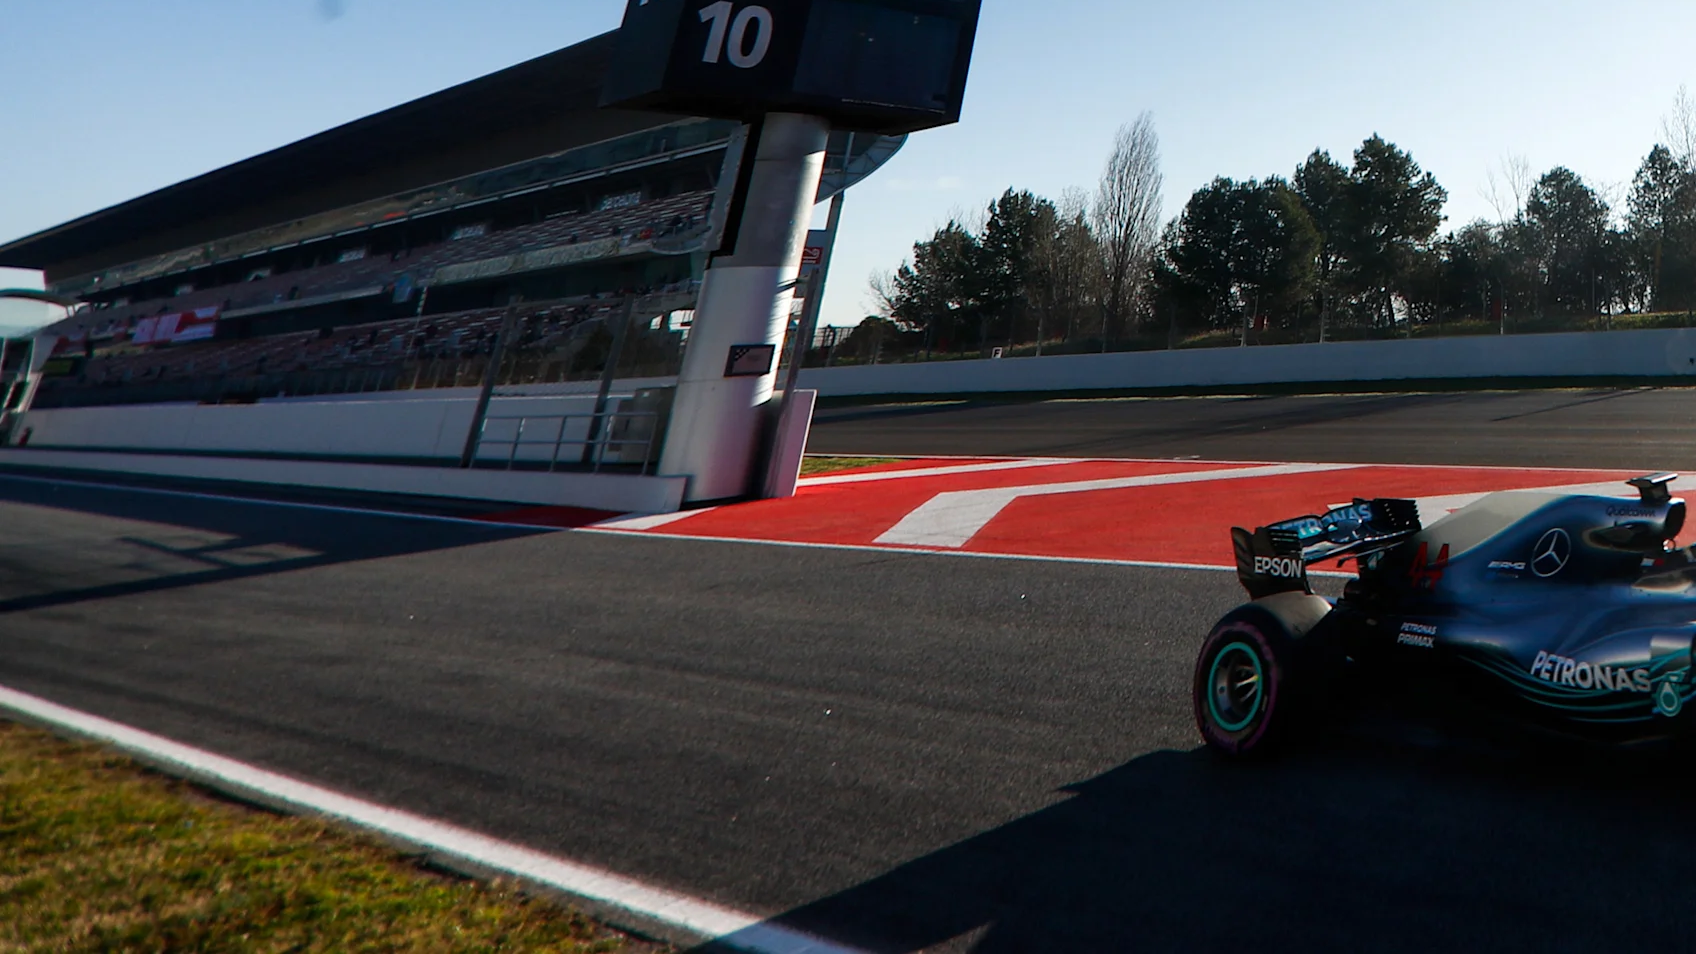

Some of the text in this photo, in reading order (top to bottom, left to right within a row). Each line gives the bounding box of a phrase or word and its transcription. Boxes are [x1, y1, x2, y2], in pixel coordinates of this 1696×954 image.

[699, 0, 774, 68] 10
[1254, 556, 1302, 579] EPSON
[1407, 541, 1449, 592] 44
[1400, 621, 1437, 635] PETRONAS
[1530, 650, 1650, 692] PETRONAS
